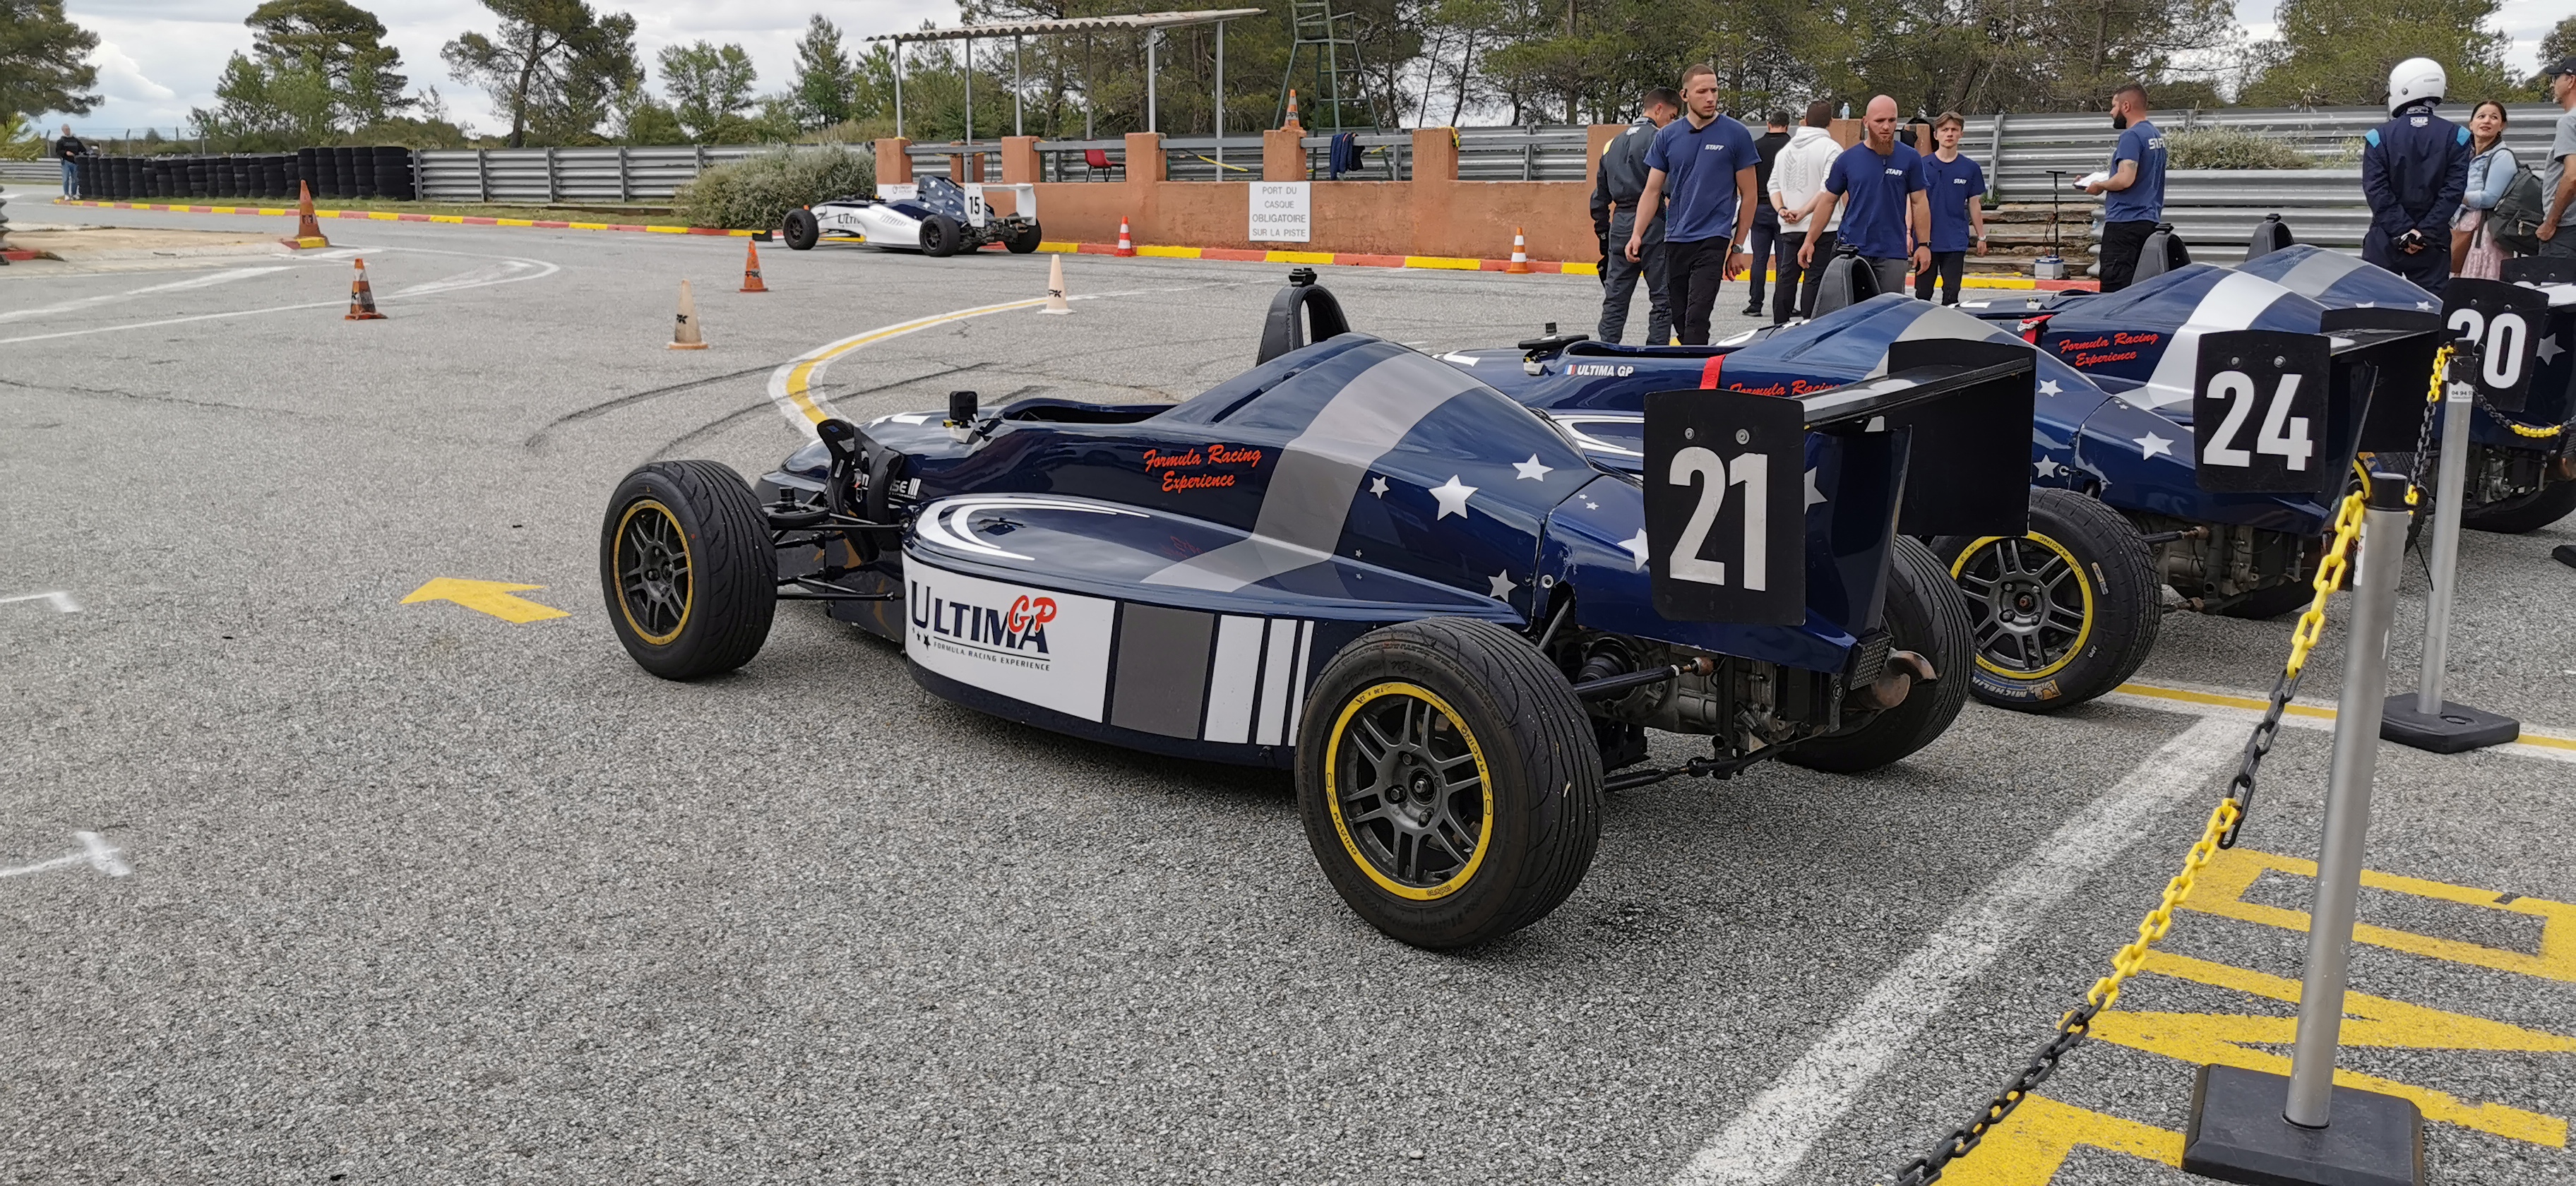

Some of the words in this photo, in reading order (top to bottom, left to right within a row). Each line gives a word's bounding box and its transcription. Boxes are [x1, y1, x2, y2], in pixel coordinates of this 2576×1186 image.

[1885, 167, 1903, 176] STAFF
[1263, 186, 1282, 195] PORT
[1286, 186, 1297, 195] DU
[970, 196, 980, 215] 15
[1264, 200, 1294, 209] CASQUE
[1252, 214, 1306, 223] OBLIGATOIRE
[1252, 228, 1268, 236] SUR
[1270, 229, 1280, 237] LA
[1283, 229, 1306, 237] PISTE
[2059, 336, 2109, 354] Formula
[2113, 333, 2159, 346] Racing
[1577, 364, 1615, 376] ULTIMA
[1617, 366, 1634, 377] GP
[2075, 351, 2137, 367] Experience
[2202, 371, 2313, 471] 24
[1143, 448, 1202, 472] Formula
[1208, 444, 1263, 468] Racing
[1162, 470, 1235, 494] Experience
[1669, 446, 1768, 592] 21
[2038, 535, 2069, 558] RACING
[911, 580, 1049, 654] ULTIMA
[1008, 594, 1057, 633] GP
[934, 641, 965, 656] FORMULA
[968, 649, 997, 662] RACING
[1000, 657, 1051, 671] EXPERIENCE
[1460, 724, 1486, 773] RACING
[1333, 811, 1358, 856] RACING
